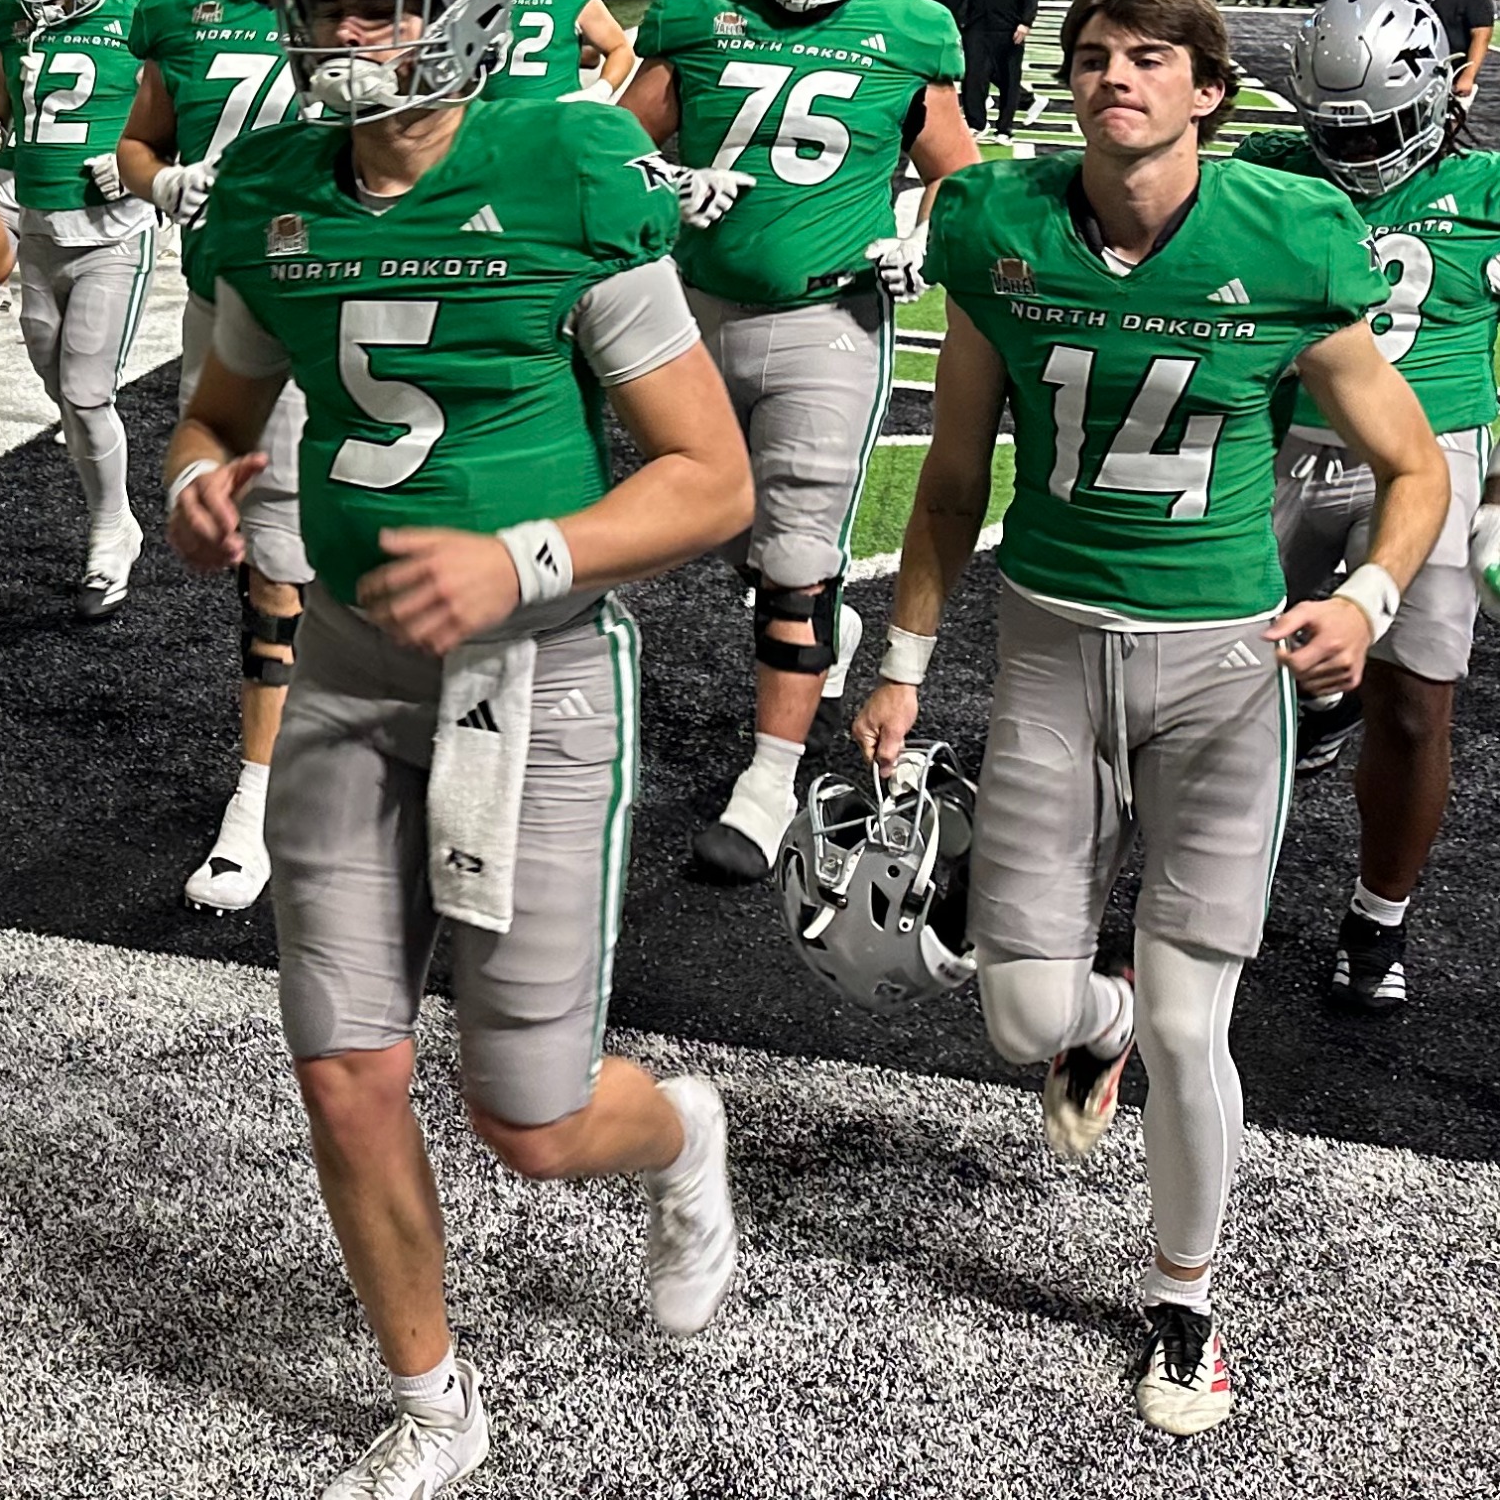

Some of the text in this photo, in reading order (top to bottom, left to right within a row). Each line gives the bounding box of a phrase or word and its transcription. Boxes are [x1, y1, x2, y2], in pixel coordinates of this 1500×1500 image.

[16, 34, 122, 49] NOTH DAKOTA
[195, 28, 257, 41] NORTH
[717, 38, 874, 68] NORTH DAKOTA
[22, 52, 97, 145] 12
[1329, 105, 1355, 116] 701
[712, 60, 863, 186] 76
[269, 258, 509, 282] NORTH DAKOTA
[1010, 301, 1257, 339] NORTH DAKOTA
[330, 299, 445, 489] 5
[1041, 344, 1226, 520] 14
